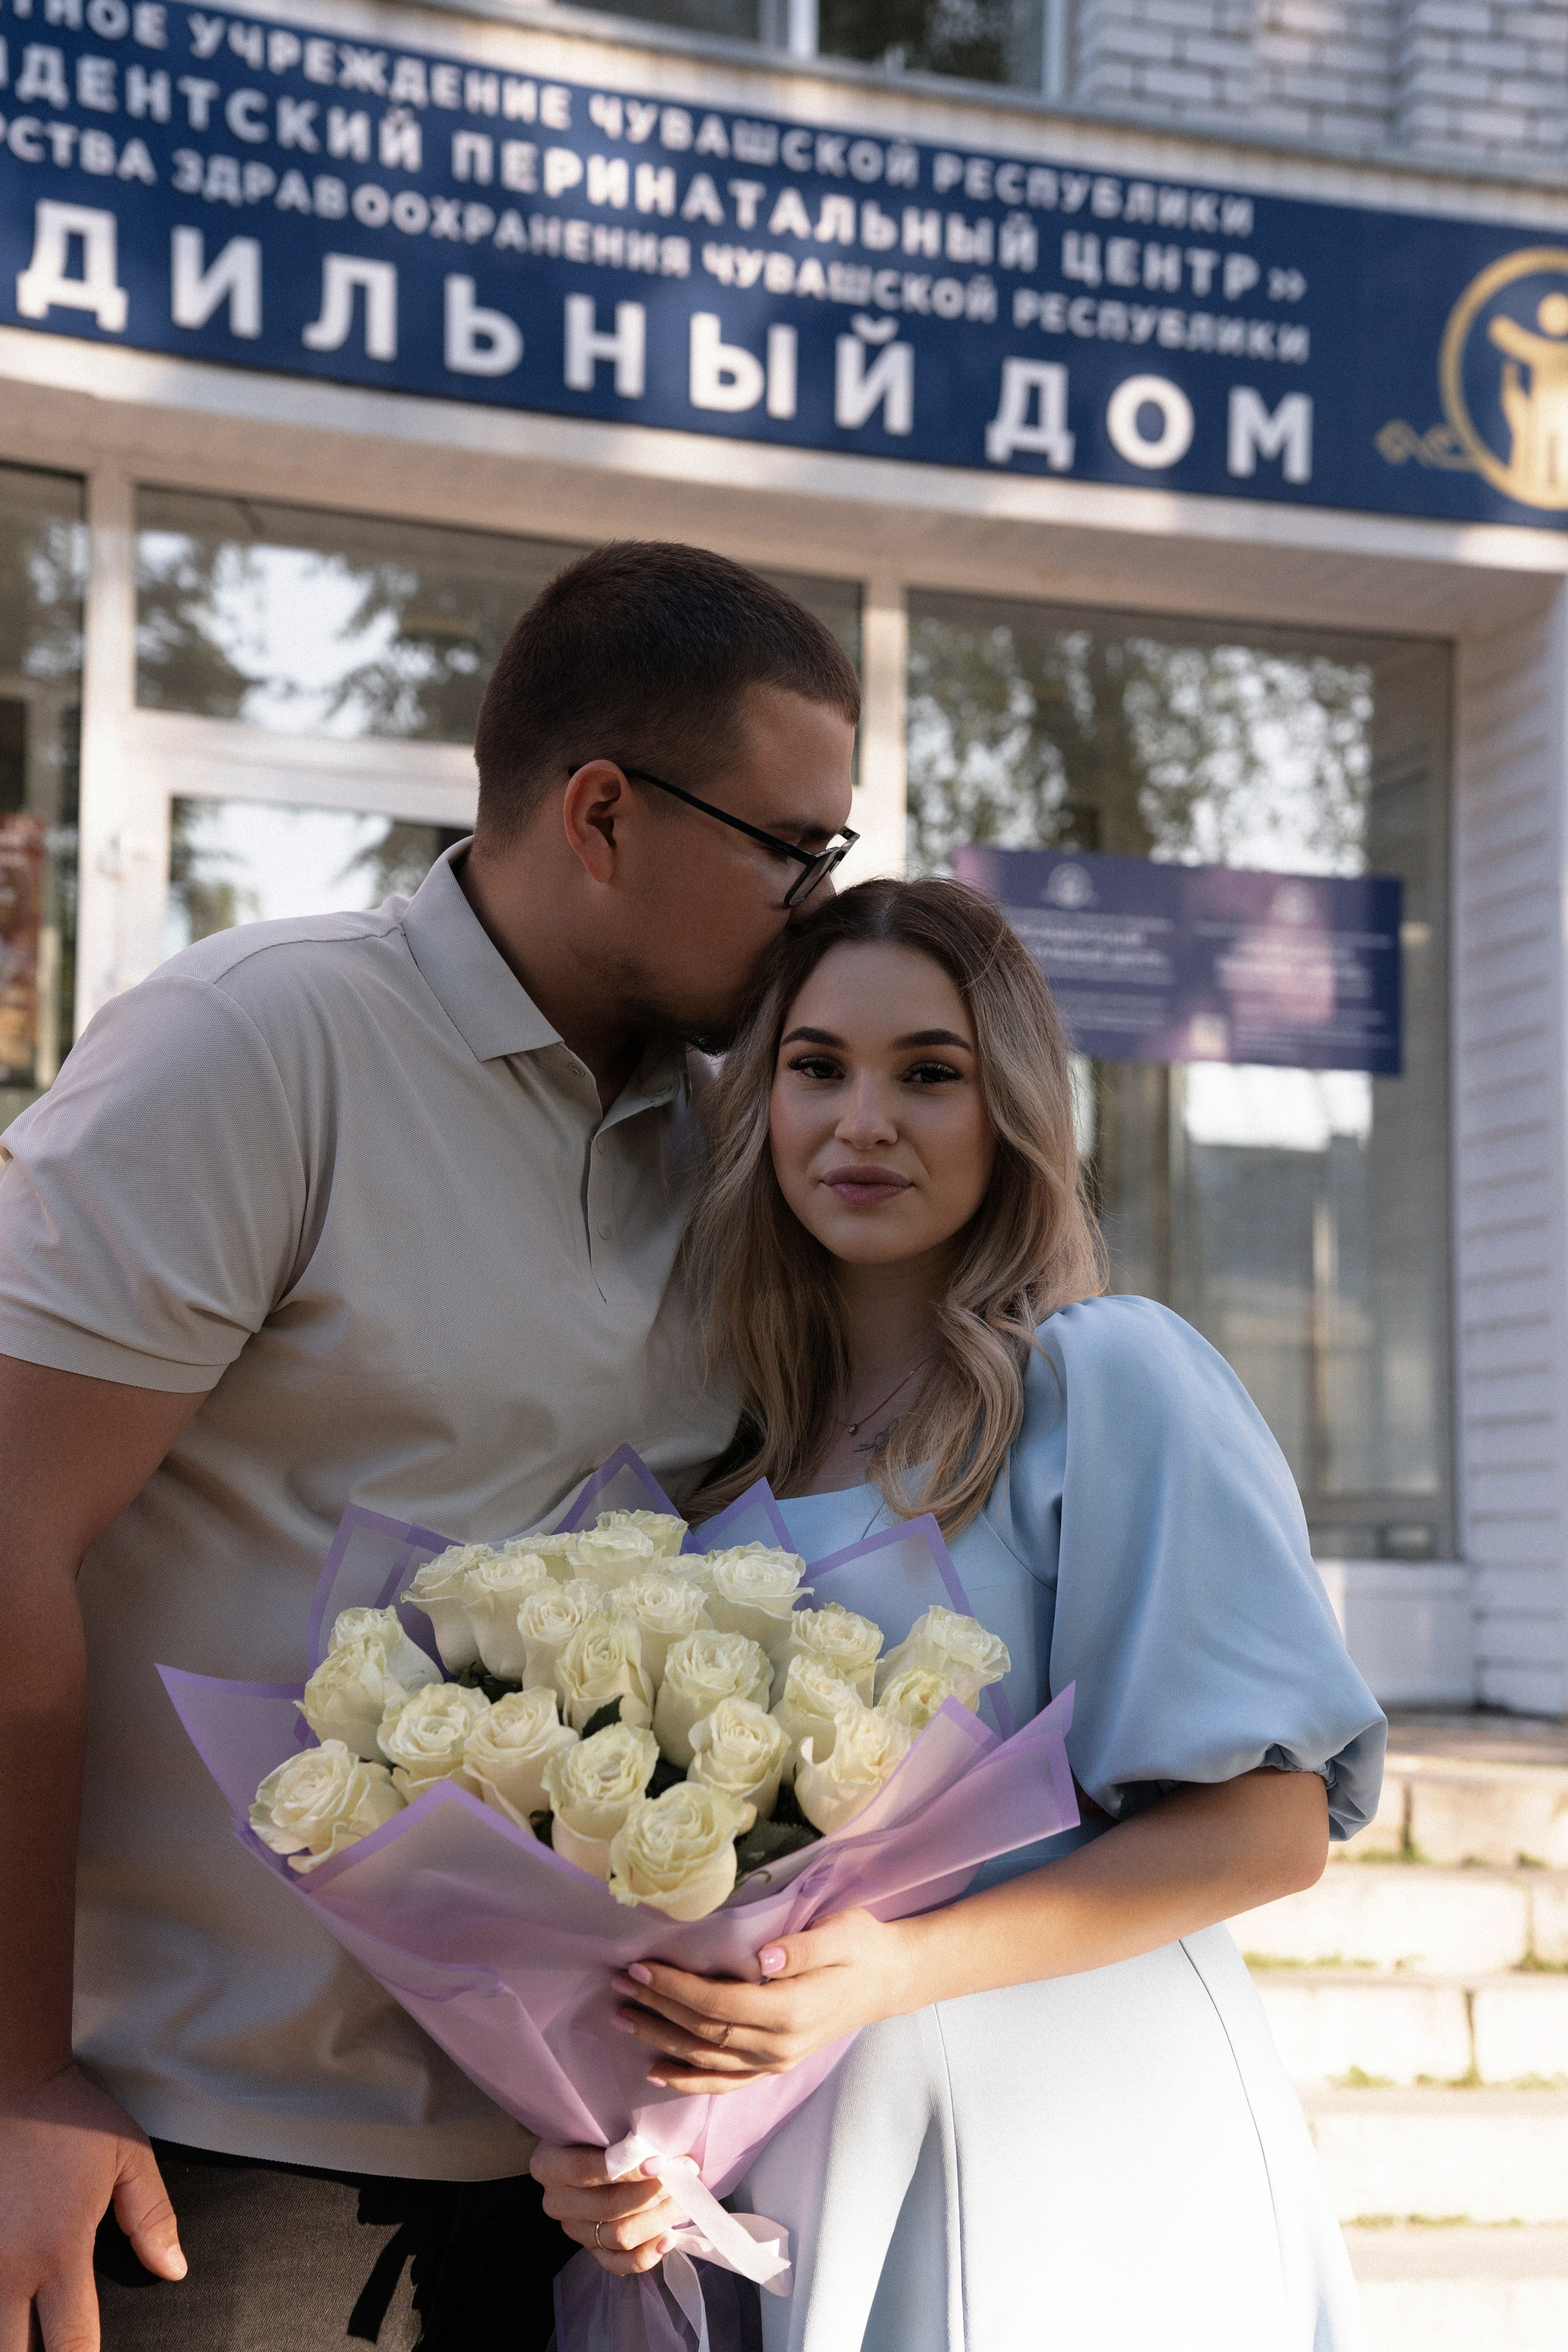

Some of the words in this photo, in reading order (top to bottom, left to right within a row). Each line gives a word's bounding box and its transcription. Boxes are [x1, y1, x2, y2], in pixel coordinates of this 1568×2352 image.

[0, 115, 157, 183] СТВА
[174, 149, 690, 276] ЗДРАВООХРАНЕНИЯ
[702, 244, 997, 320] ЧУВАШСКОЙ
[1014, 290, 1310, 361] РЕСПУБЛИКИ
[189, 13, 570, 130] УЧРЕЖДЕНИЕ
[589, 95, 919, 187] ЧУВАШСКОЙ
[933, 153, 1254, 236] РЕСПУБЛИКИ
[453, 132, 1036, 270] ПЕРИНАТАЛЬНЫЙ
[17, 200, 913, 434] ДИЛЬНЫЙ
[987, 358, 1311, 481] ДОМ
